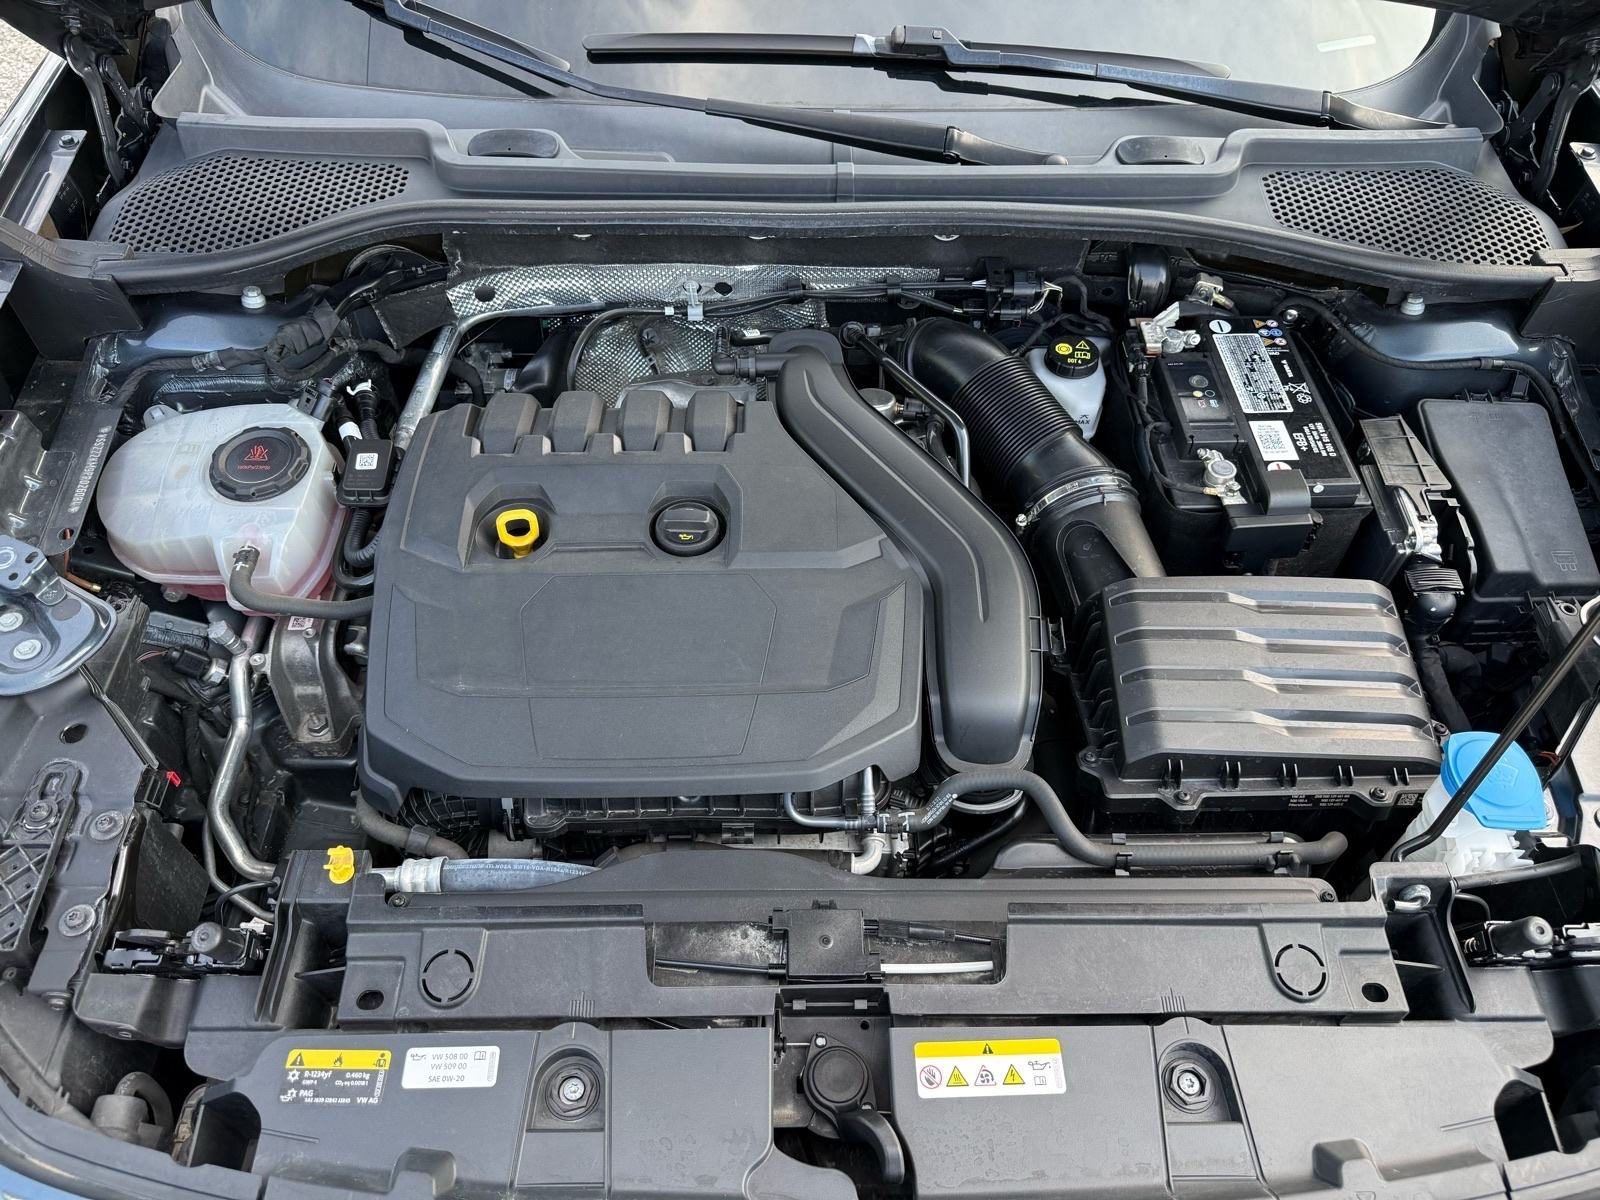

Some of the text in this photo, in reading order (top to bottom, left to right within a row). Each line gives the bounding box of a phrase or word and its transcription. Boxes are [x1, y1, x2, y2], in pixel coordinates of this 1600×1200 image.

[1292, 432, 1308, 451] EFB+
[304, 1070, 332, 1080] R-1234yf
[363, 1072, 370, 1080] kg
